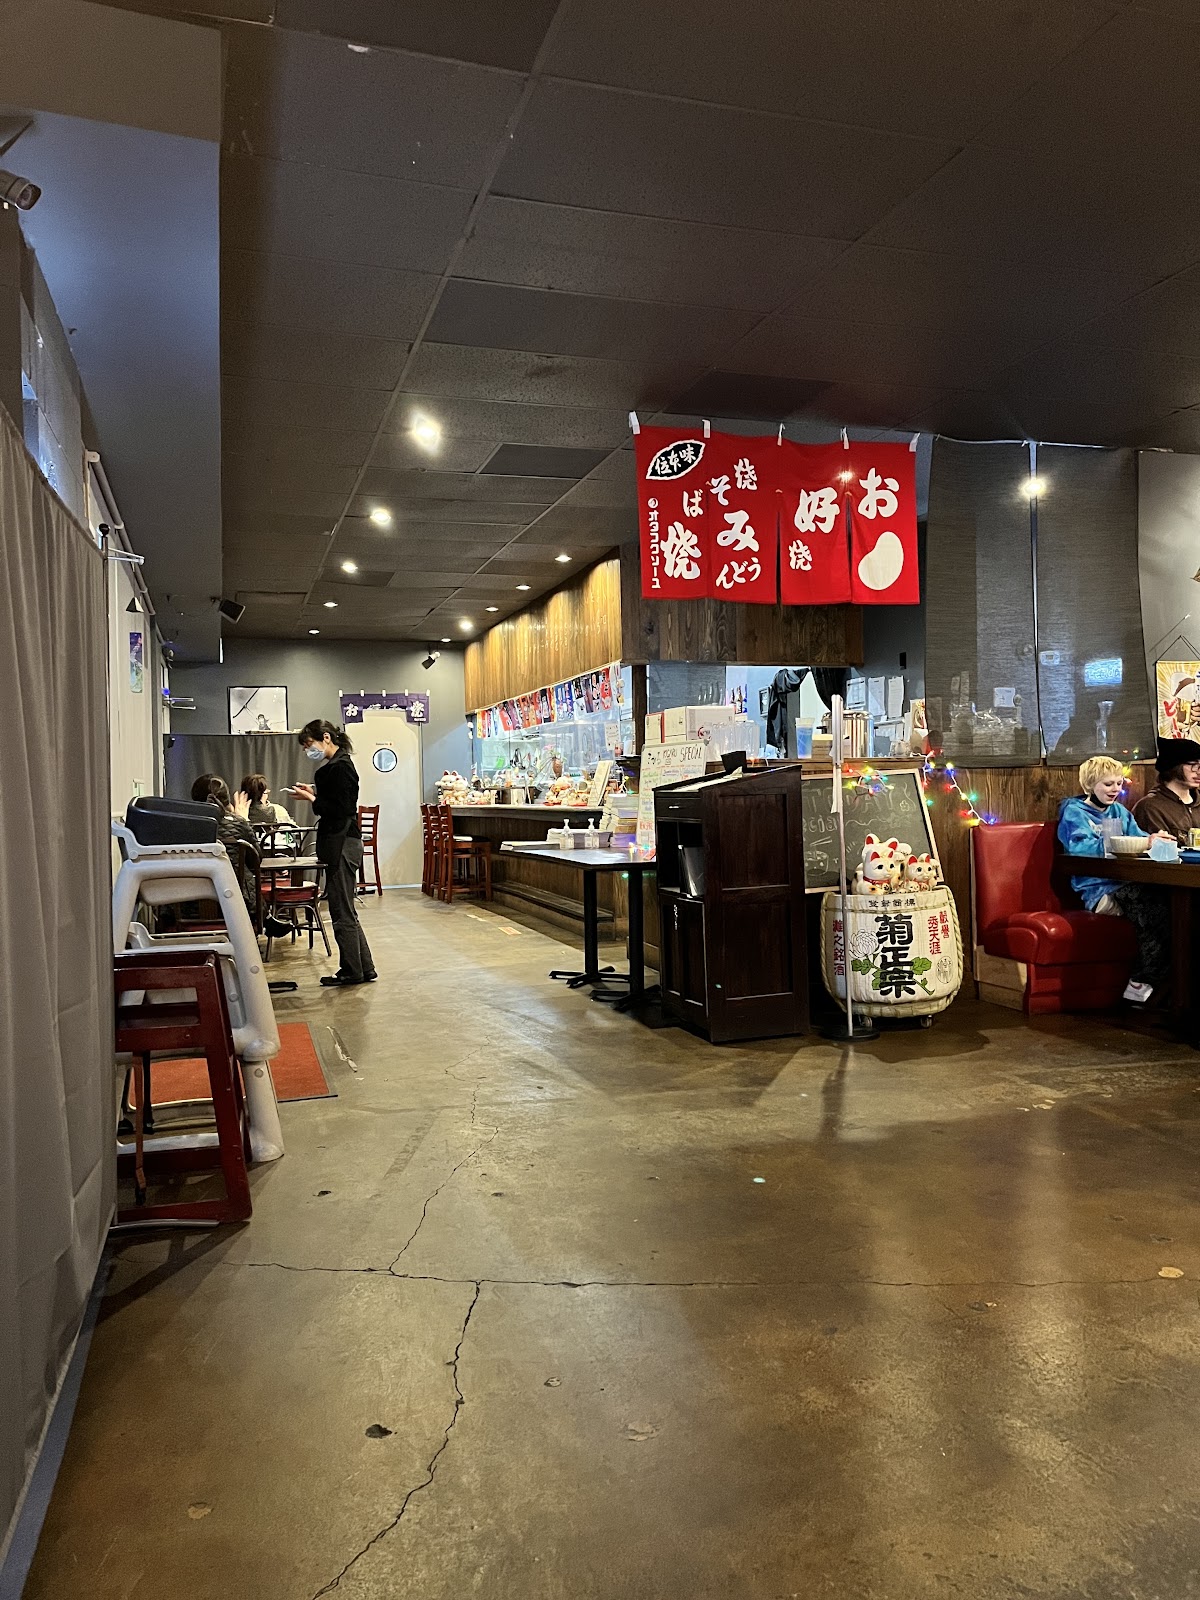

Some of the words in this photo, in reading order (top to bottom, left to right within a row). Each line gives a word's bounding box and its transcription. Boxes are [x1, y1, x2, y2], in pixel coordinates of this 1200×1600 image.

[1164, 697, 1182, 739] ビー
[875, 913, 916, 998] 菊正宗
